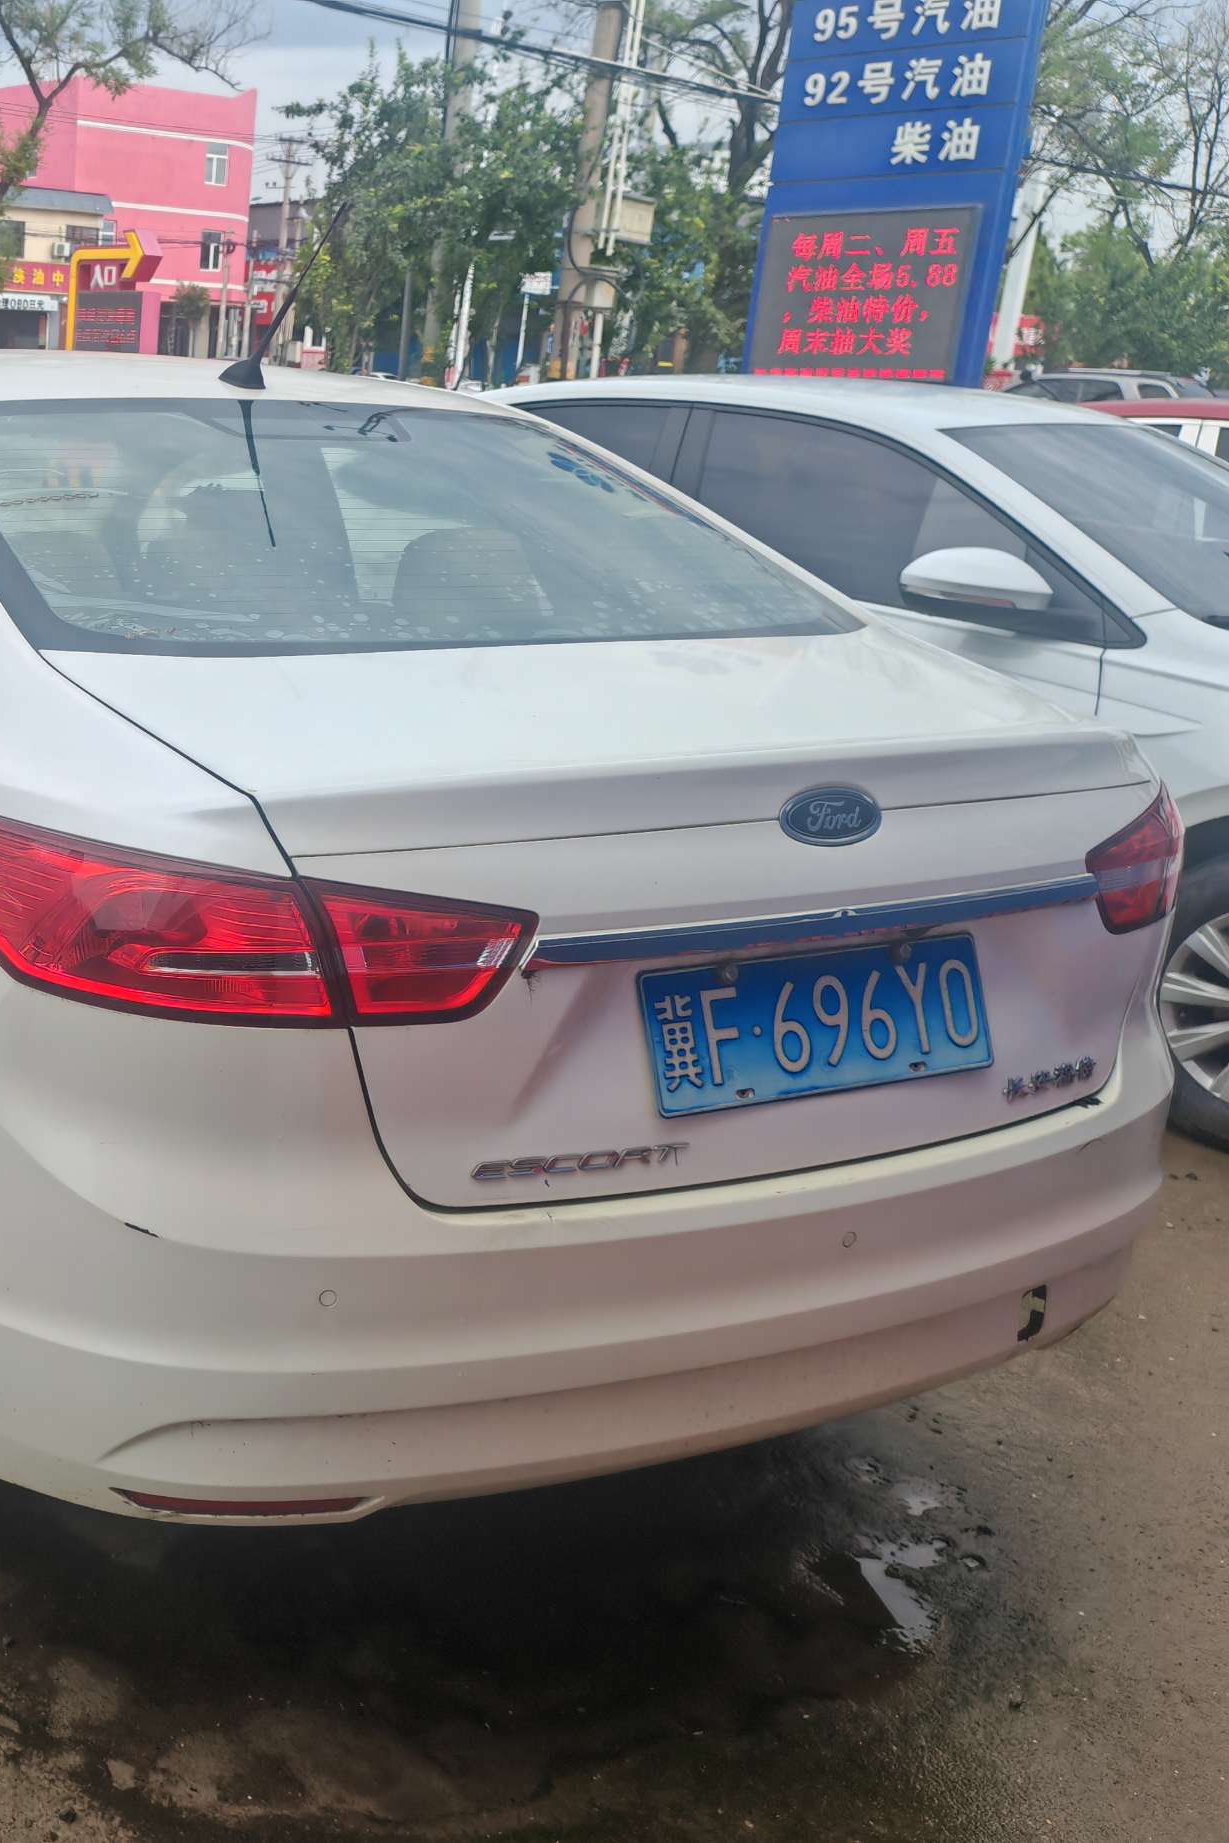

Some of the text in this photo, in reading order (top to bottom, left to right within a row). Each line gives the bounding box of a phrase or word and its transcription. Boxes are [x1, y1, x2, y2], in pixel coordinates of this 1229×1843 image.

[813, 0, 1001, 42] 95号汽油
[803, 52, 992, 107] 92号汽油
[890, 117, 980, 165] 柴油
[791, 227, 960, 261] 每周二、周五
[90, 264, 117, 289] 入口
[777, 328, 912, 356] 周末抽大奖
[807, 801, 862, 832] Ford
[471, 1142, 690, 1180] ESCORT
